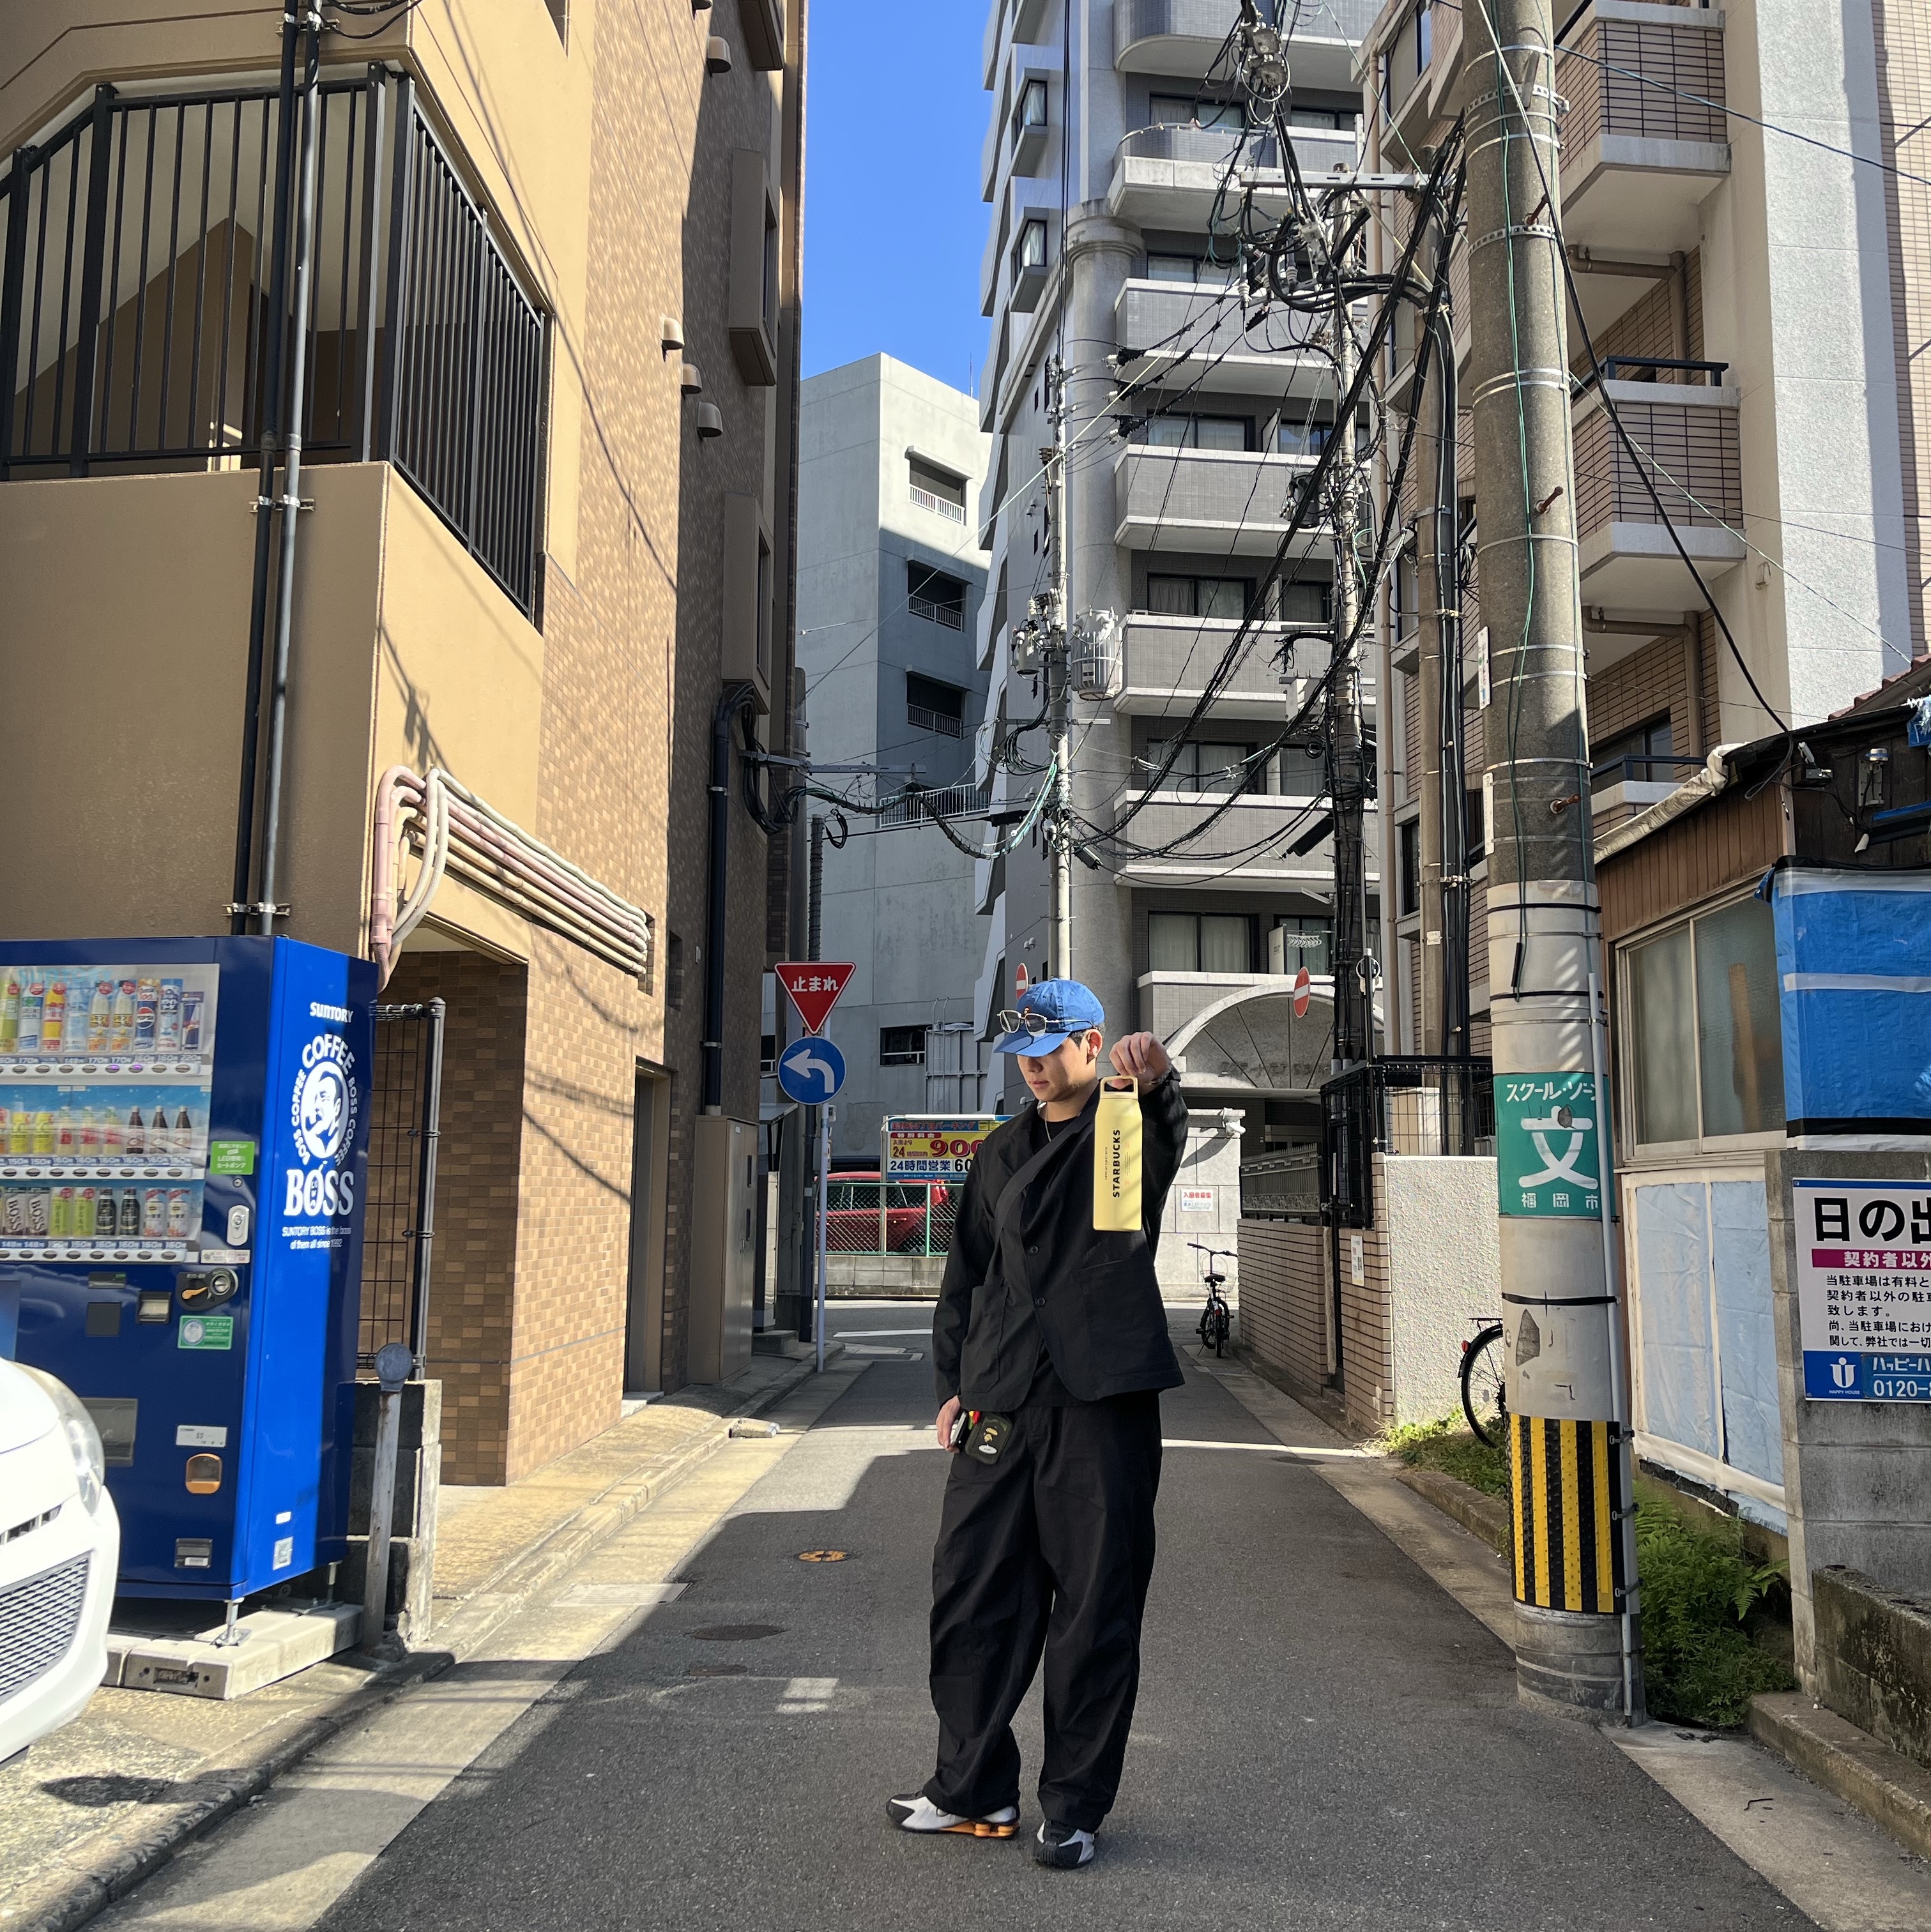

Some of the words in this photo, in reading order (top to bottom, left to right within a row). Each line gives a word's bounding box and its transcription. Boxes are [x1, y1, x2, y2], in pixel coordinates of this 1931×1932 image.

[791, 976, 839, 993] 止まれ
[310, 1001, 353, 1023] SUNTORY
[301, 1033, 355, 1075] COFFEE
[349, 1076, 358, 1114] BOSS
[334, 1119, 356, 1166] COFFEE
[890, 1160, 951, 1171] 24時間営業
[284, 1169, 354, 1216] BOSS
[1522, 1192, 1598, 1210] 福岡市
[282, 1226, 309, 1236] SUNTORY
[310, 1226, 326, 1236] BOSS
[1844, 1251, 1931, 1268] 契約者以外
[1826, 1275, 1930, 1288] 当駐車場は有料と
[1827, 1304, 1890, 1317] 致します。
[1829, 1320, 1931, 1333] 尚、当駐車場におけ
[1829, 1335, 1931, 1348] 関して、弊社では一切
[1873, 1357, 1931, 1371] ハッピーハ
[1874, 1380, 1931, 1397] 0120-
